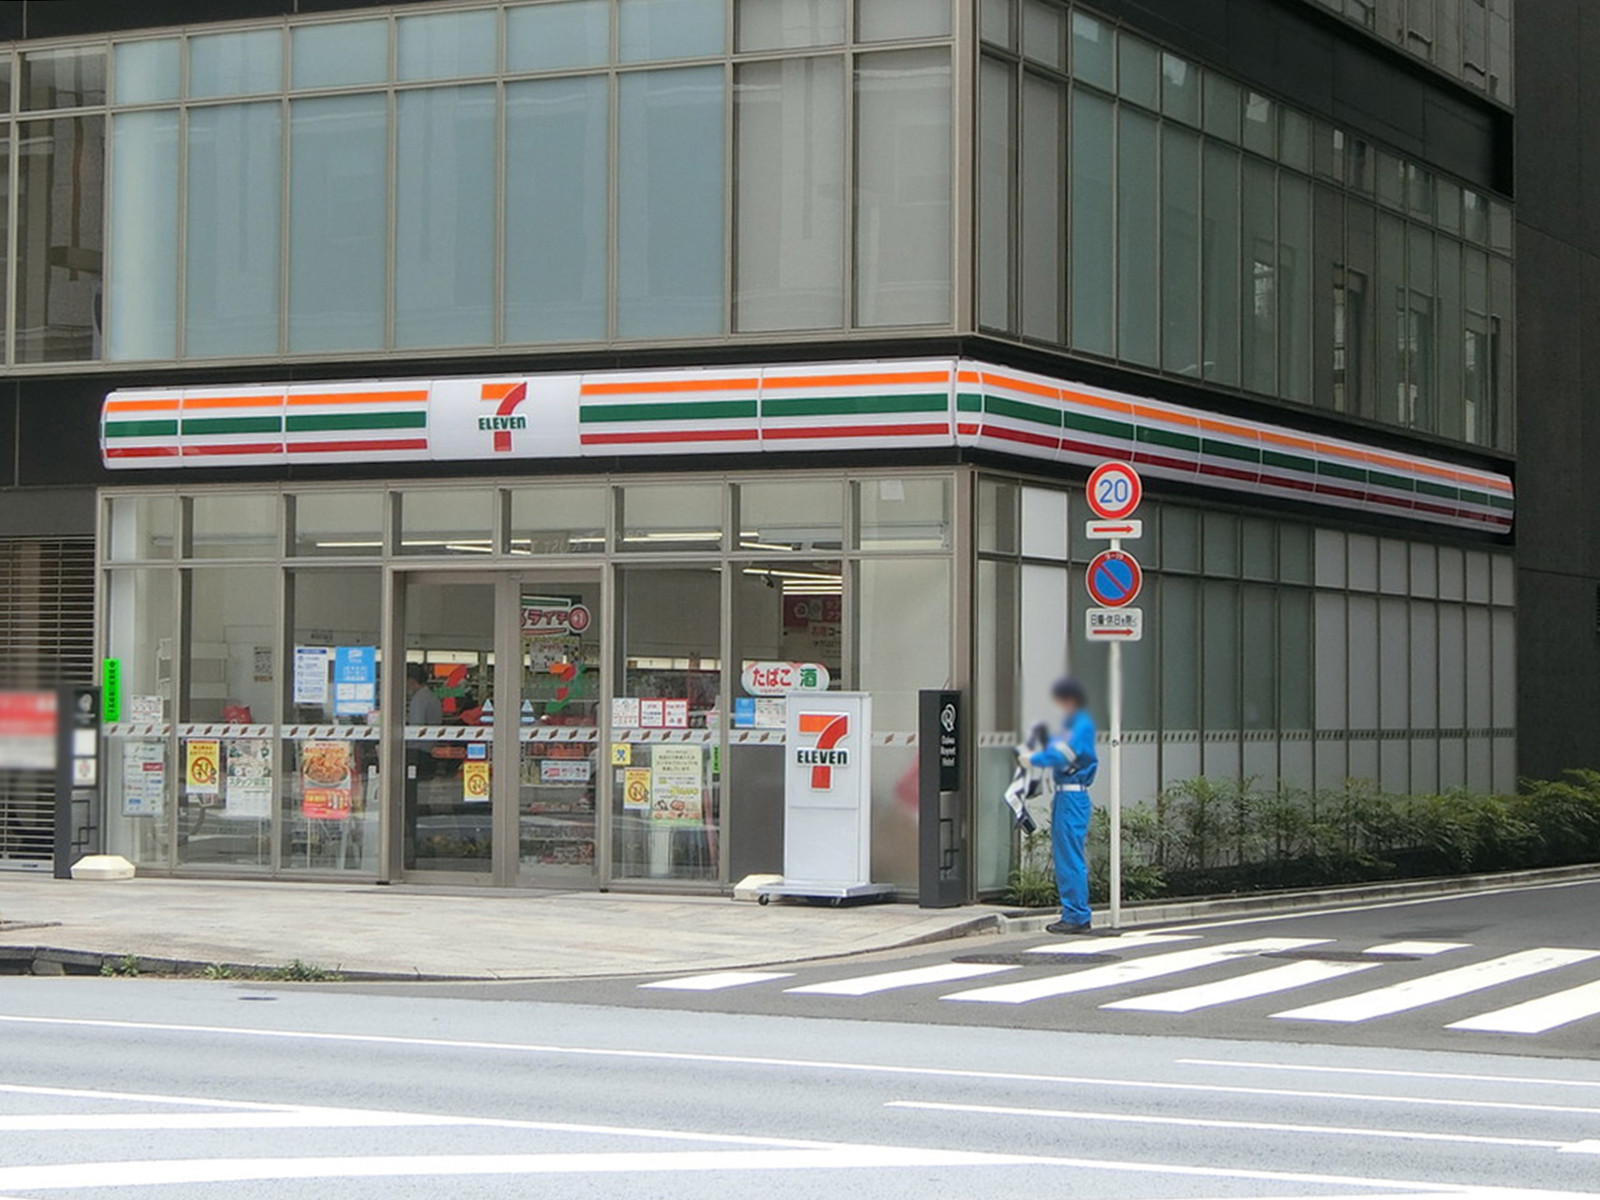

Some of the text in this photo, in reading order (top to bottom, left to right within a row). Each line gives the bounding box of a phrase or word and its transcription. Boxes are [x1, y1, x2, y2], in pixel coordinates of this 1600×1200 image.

[481, 381, 527, 451] 7
[1099, 478, 1128, 503] 20
[752, 667, 817, 687] たばこ 酒
[799, 713, 848, 789] 7
